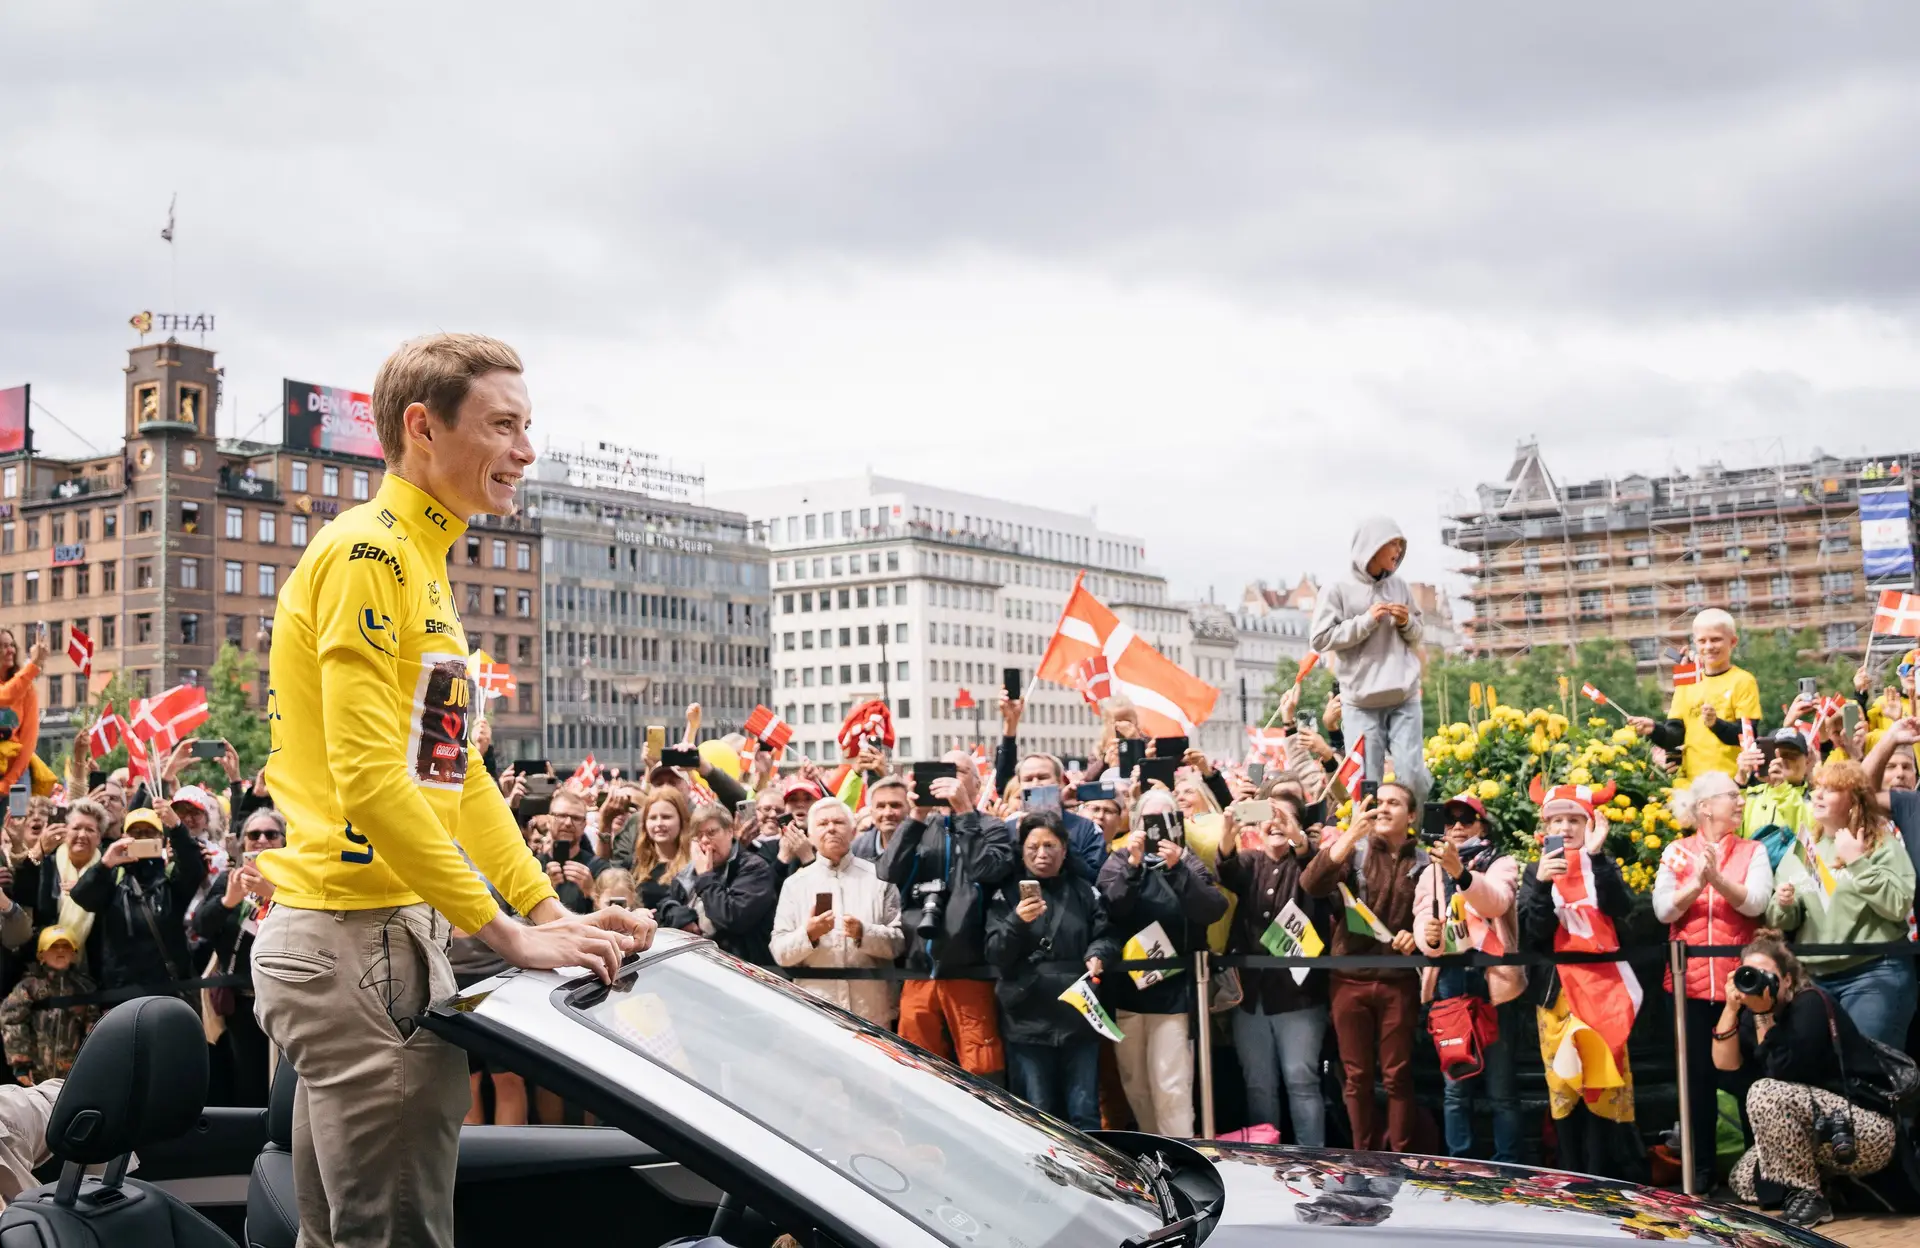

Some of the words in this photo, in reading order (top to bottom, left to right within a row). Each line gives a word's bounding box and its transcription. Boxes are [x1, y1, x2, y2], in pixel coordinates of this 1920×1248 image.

[157, 313, 215, 332] THAI
[424, 505, 448, 532] LCL
[55, 542, 84, 563] BDO
[616, 528, 646, 546] Hotel
[655, 532, 677, 549] The
[679, 535, 714, 555] Square
[1284, 913, 1307, 943] BON
